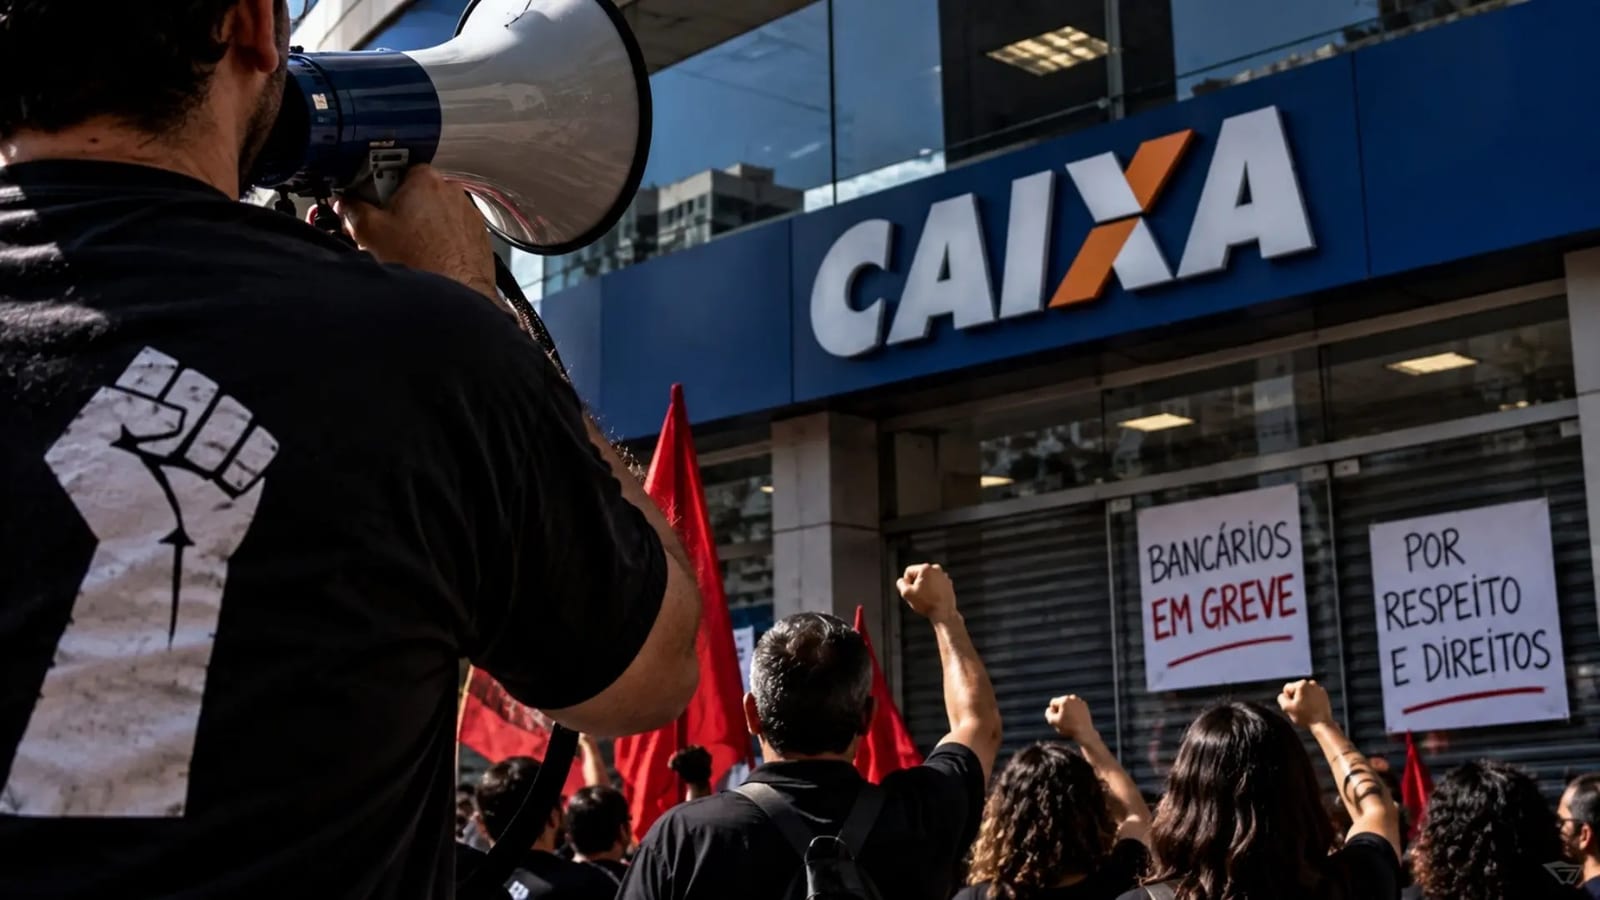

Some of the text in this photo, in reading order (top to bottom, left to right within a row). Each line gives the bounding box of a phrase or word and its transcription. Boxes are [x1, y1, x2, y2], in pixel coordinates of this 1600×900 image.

[810, 105, 1316, 357] CAIXA
[1147, 520, 1293, 585] BANCÁRIOS
[1403, 527, 1466, 573] POR
[1151, 573, 1298, 642] EM GREVE
[1382, 573, 1522, 632] RESPEITO
[1390, 628, 1552, 688] E DIREITOS
